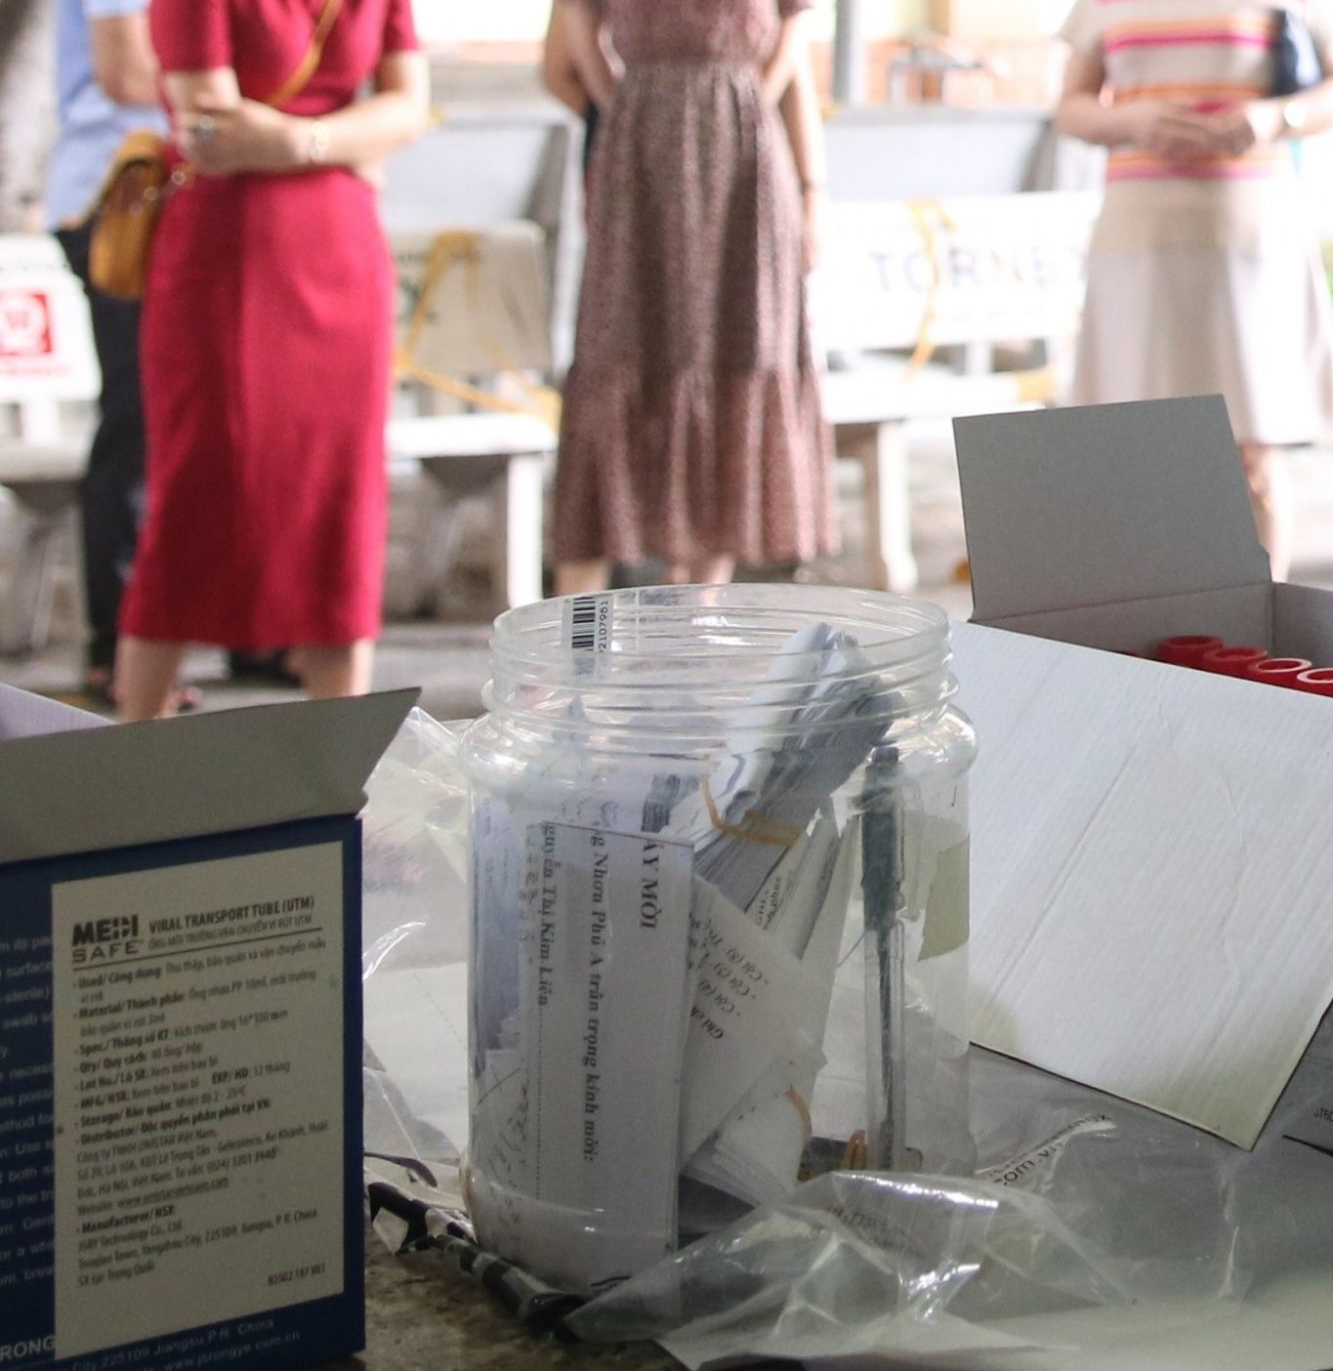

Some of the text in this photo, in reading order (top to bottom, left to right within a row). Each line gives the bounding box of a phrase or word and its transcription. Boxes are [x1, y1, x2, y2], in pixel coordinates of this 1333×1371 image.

[149, 895, 314, 933] VIRAL TRANSPORT TUBE (UTM)
[72, 939, 138, 964] SAFE
